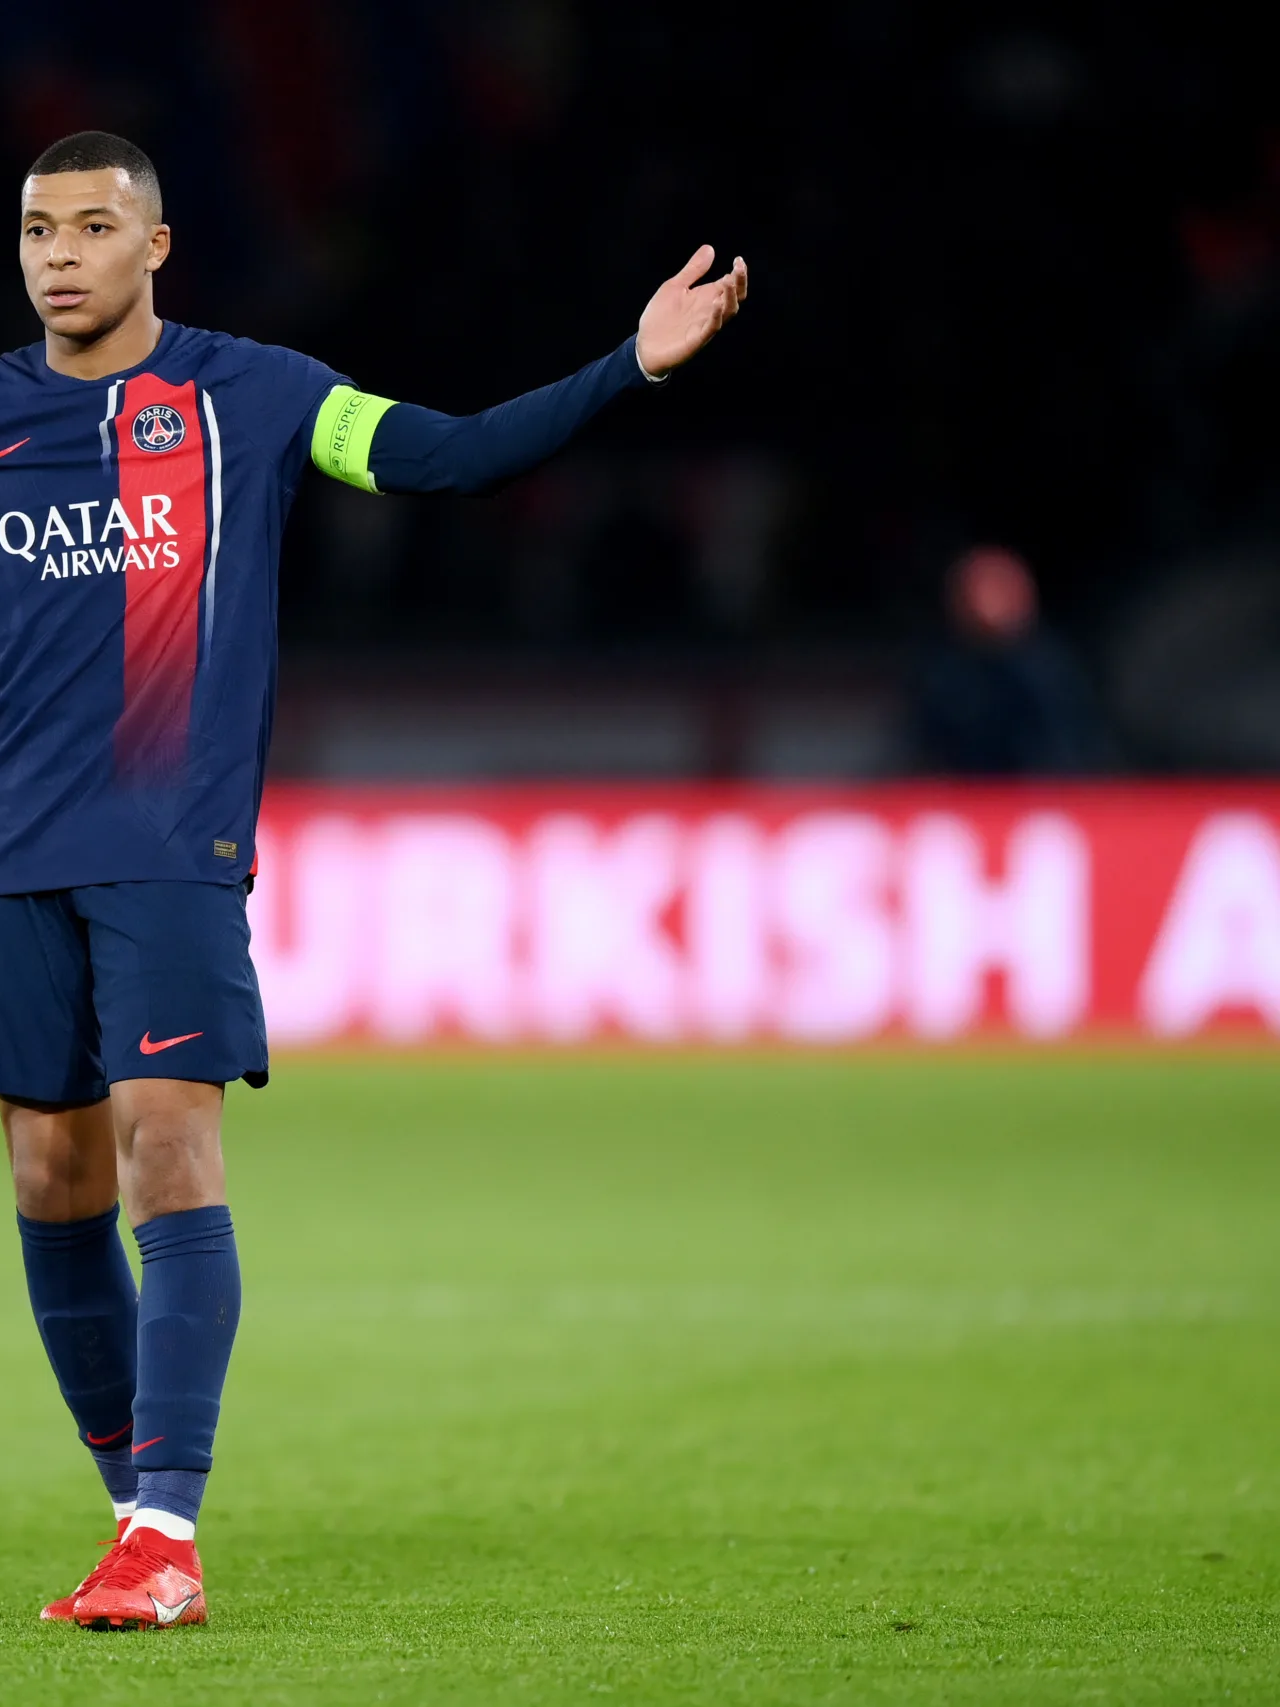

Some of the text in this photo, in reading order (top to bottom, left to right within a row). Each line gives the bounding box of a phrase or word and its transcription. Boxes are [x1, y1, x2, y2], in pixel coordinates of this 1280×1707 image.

[139, 408, 173, 422] PARIS
[40, 541, 180, 581] AIRWAYS
[254, 812, 1090, 1046] URKISH
